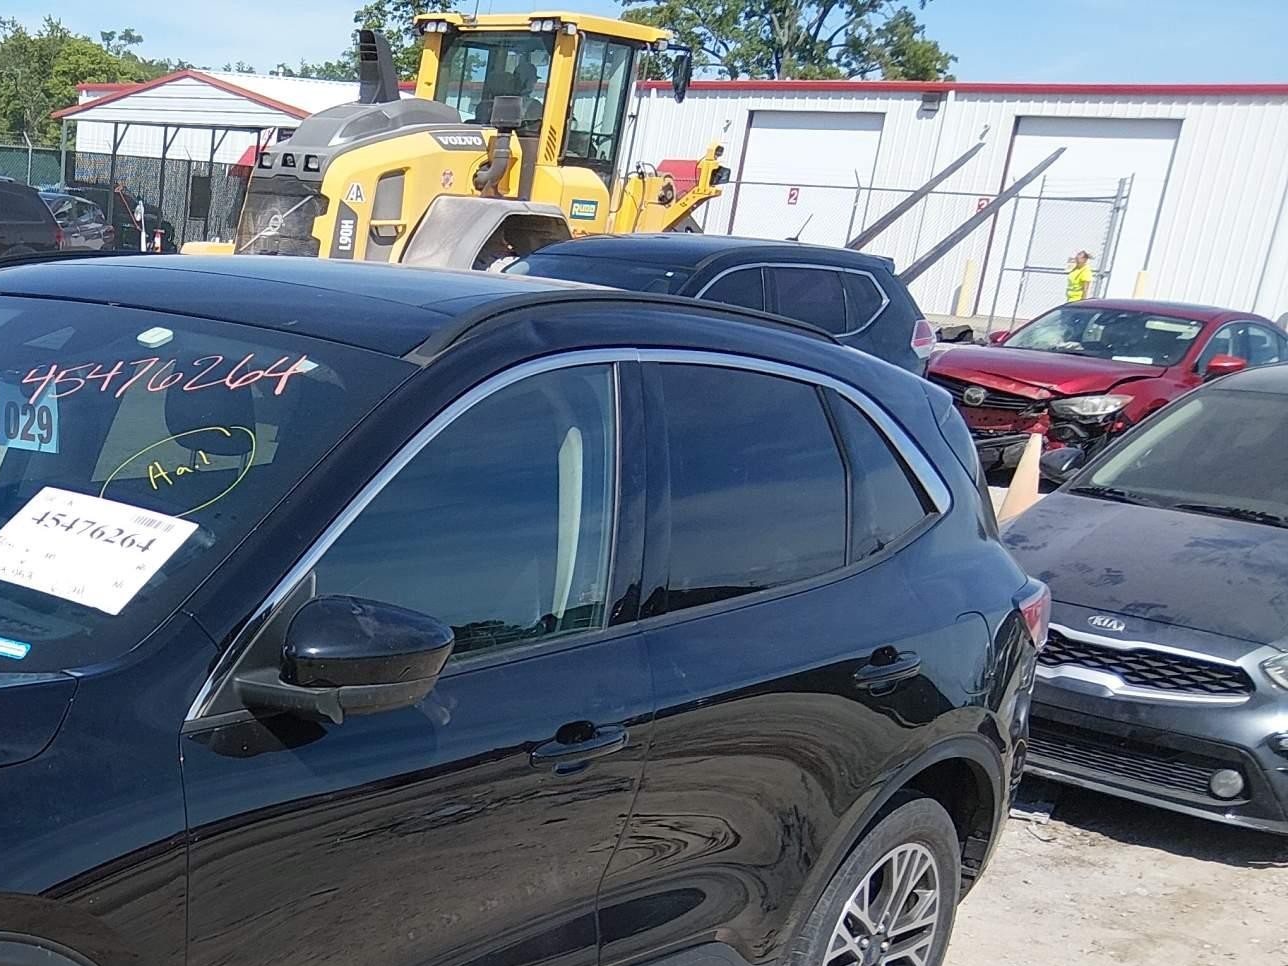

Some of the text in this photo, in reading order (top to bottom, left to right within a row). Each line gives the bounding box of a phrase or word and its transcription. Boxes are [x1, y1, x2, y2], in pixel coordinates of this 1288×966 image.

[437, 136, 482, 146] VOLVO
[789, 190, 798, 203] 2
[339, 219, 354, 250] L90H
[22, 353, 307, 405] 45476264
[5, 401, 53, 444] 029
[32, 511, 157, 553] 45476264
[1092, 615, 1120, 629] KIA
